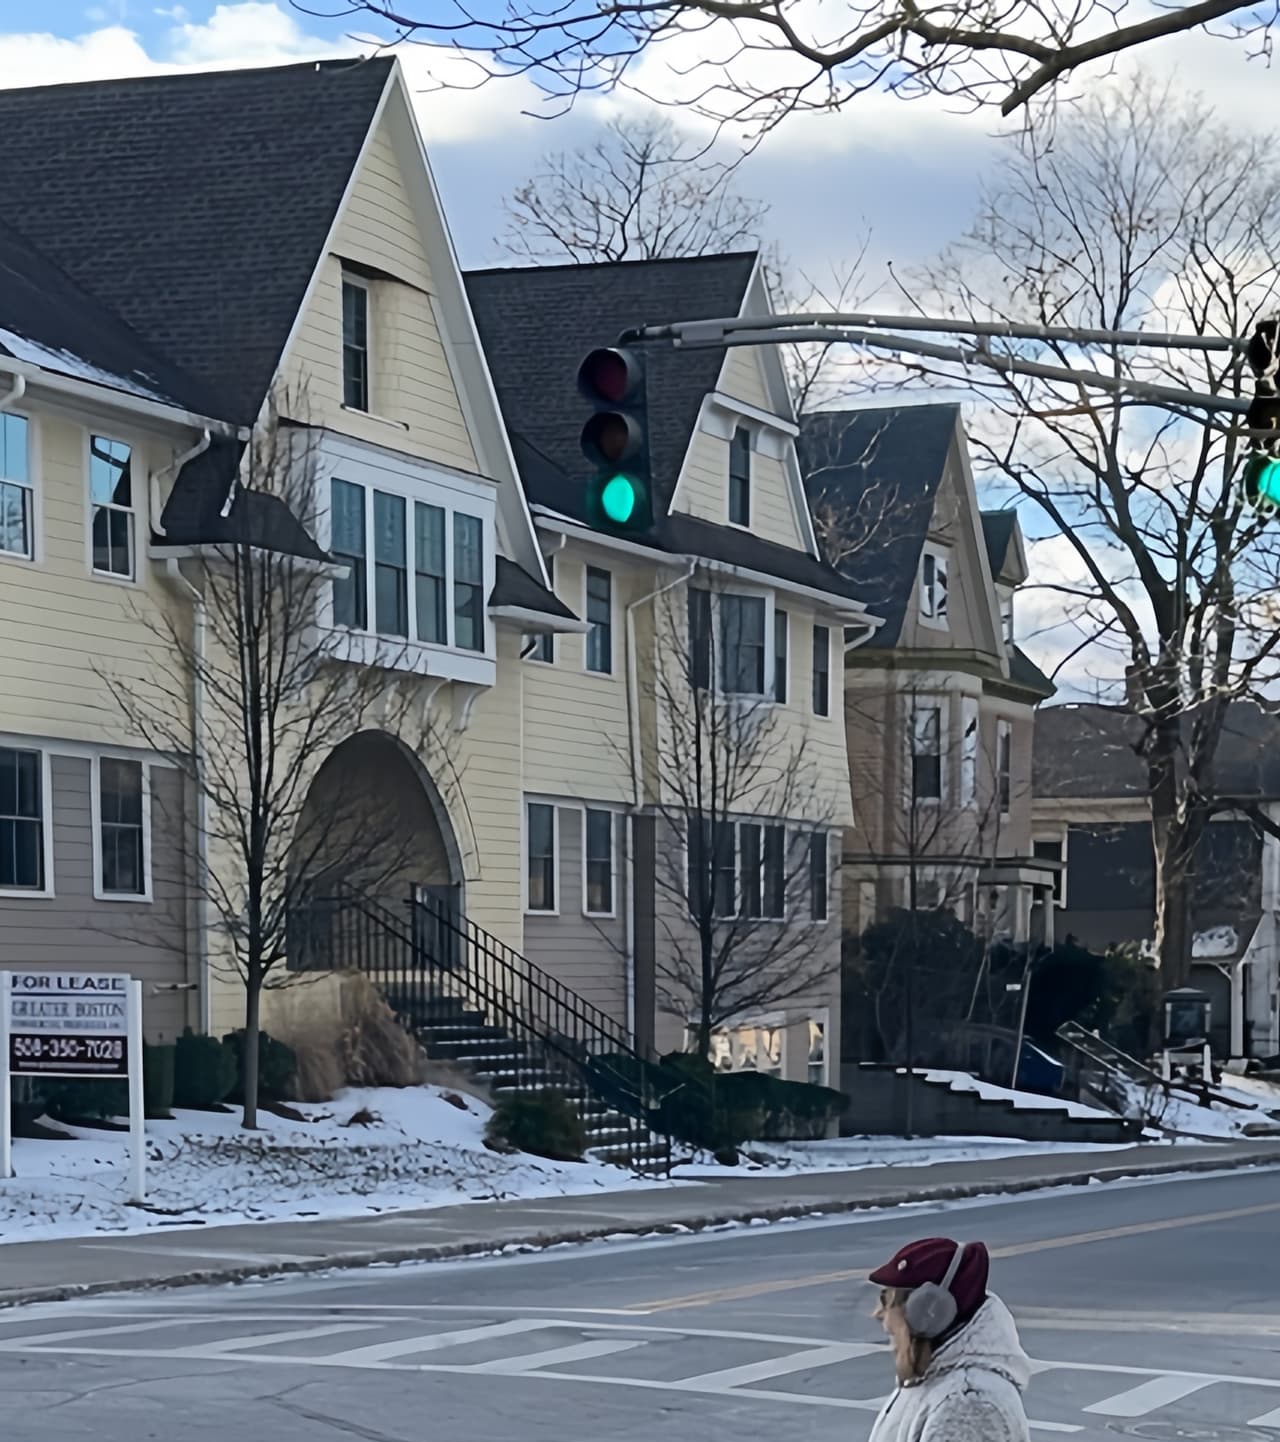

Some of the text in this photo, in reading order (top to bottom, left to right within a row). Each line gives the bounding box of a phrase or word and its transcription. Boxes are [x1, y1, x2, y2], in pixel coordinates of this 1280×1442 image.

[11, 975, 125, 990] FOR LEASE
[75, 1002, 124, 1017] BOSTON
